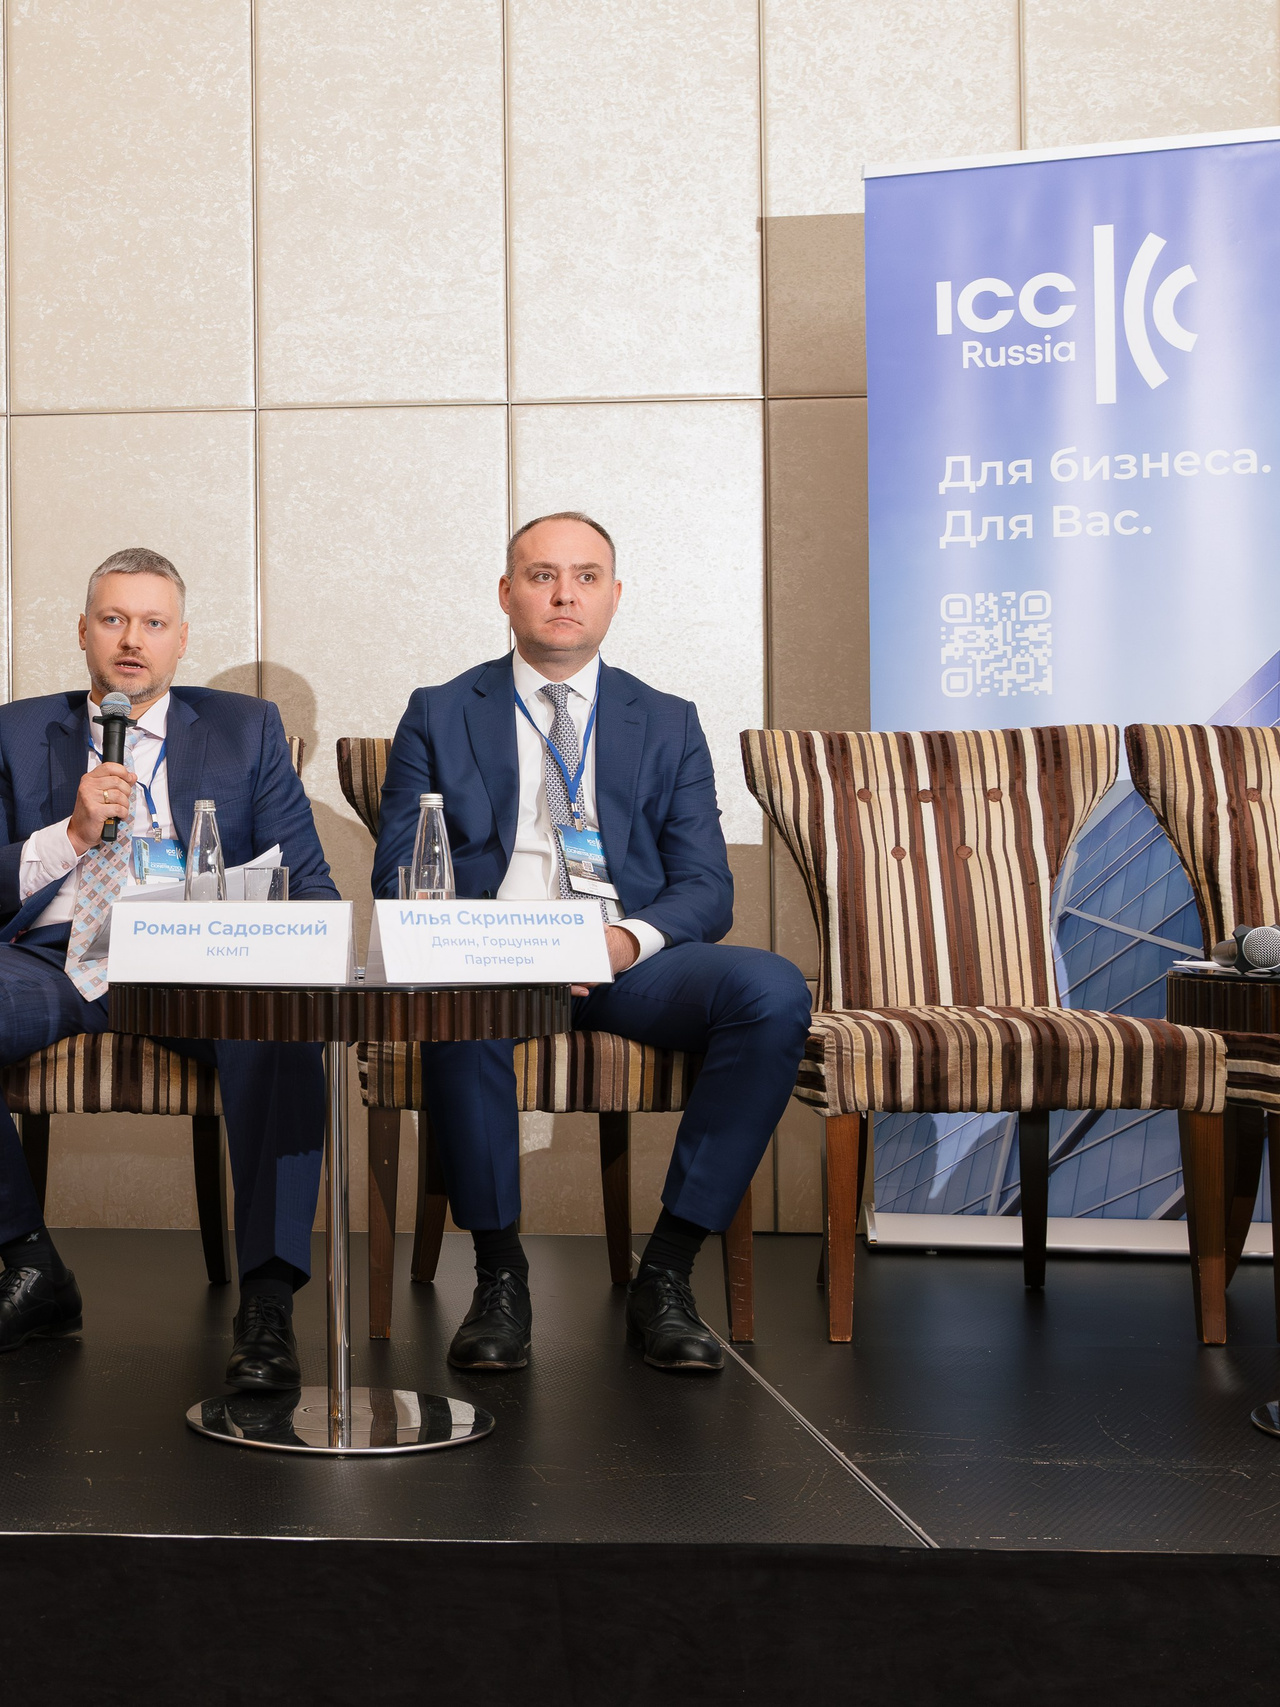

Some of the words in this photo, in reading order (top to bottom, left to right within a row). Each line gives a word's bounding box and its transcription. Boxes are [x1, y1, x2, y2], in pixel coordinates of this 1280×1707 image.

[935, 272, 1078, 335] ICC
[962, 335, 1077, 370] Russia
[939, 455, 1032, 494] Для
[1049, 445, 1272, 483] бизнеса.
[940, 510, 1033, 549] Для
[1053, 505, 1152, 539] Вас.
[133, 920, 201, 936] Роман
[207, 919, 328, 938] Садовский
[399, 910, 451, 926] Илья
[456, 910, 585, 928] Скрипников
[205, 945, 249, 957] ККМП
[431, 936, 480, 948] Дякин,
[482, 935, 549, 950] Горцунян
[551, 938, 561, 947] и
[463, 953, 535, 967] Партнеры
